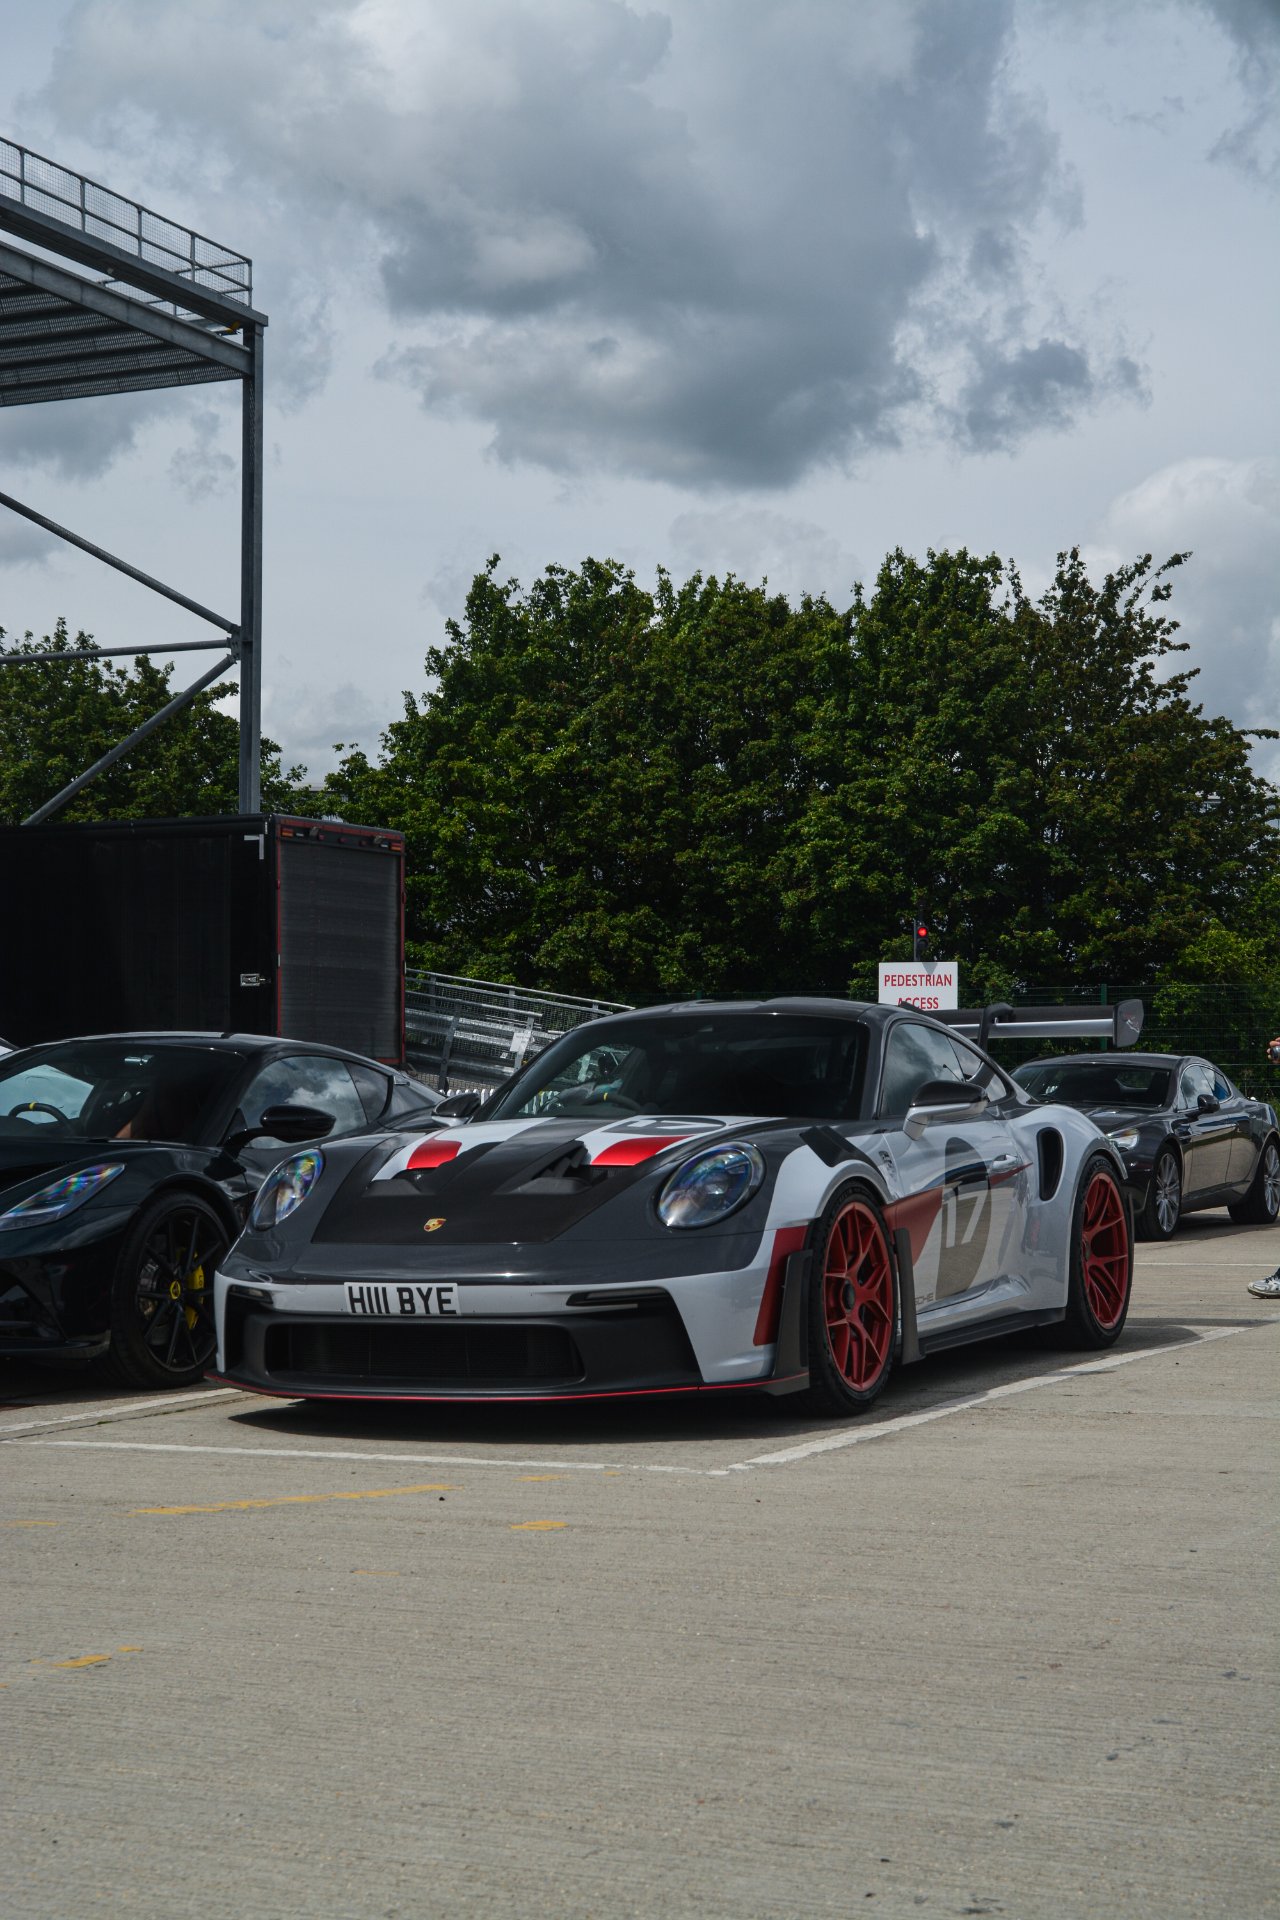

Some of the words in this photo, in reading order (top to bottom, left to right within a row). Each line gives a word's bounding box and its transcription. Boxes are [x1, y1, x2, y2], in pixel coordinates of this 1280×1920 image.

[884, 974, 952, 987] PEDESTRIAN
[942, 1189, 988, 1249] 17
[396, 1287, 457, 1315] BYE
